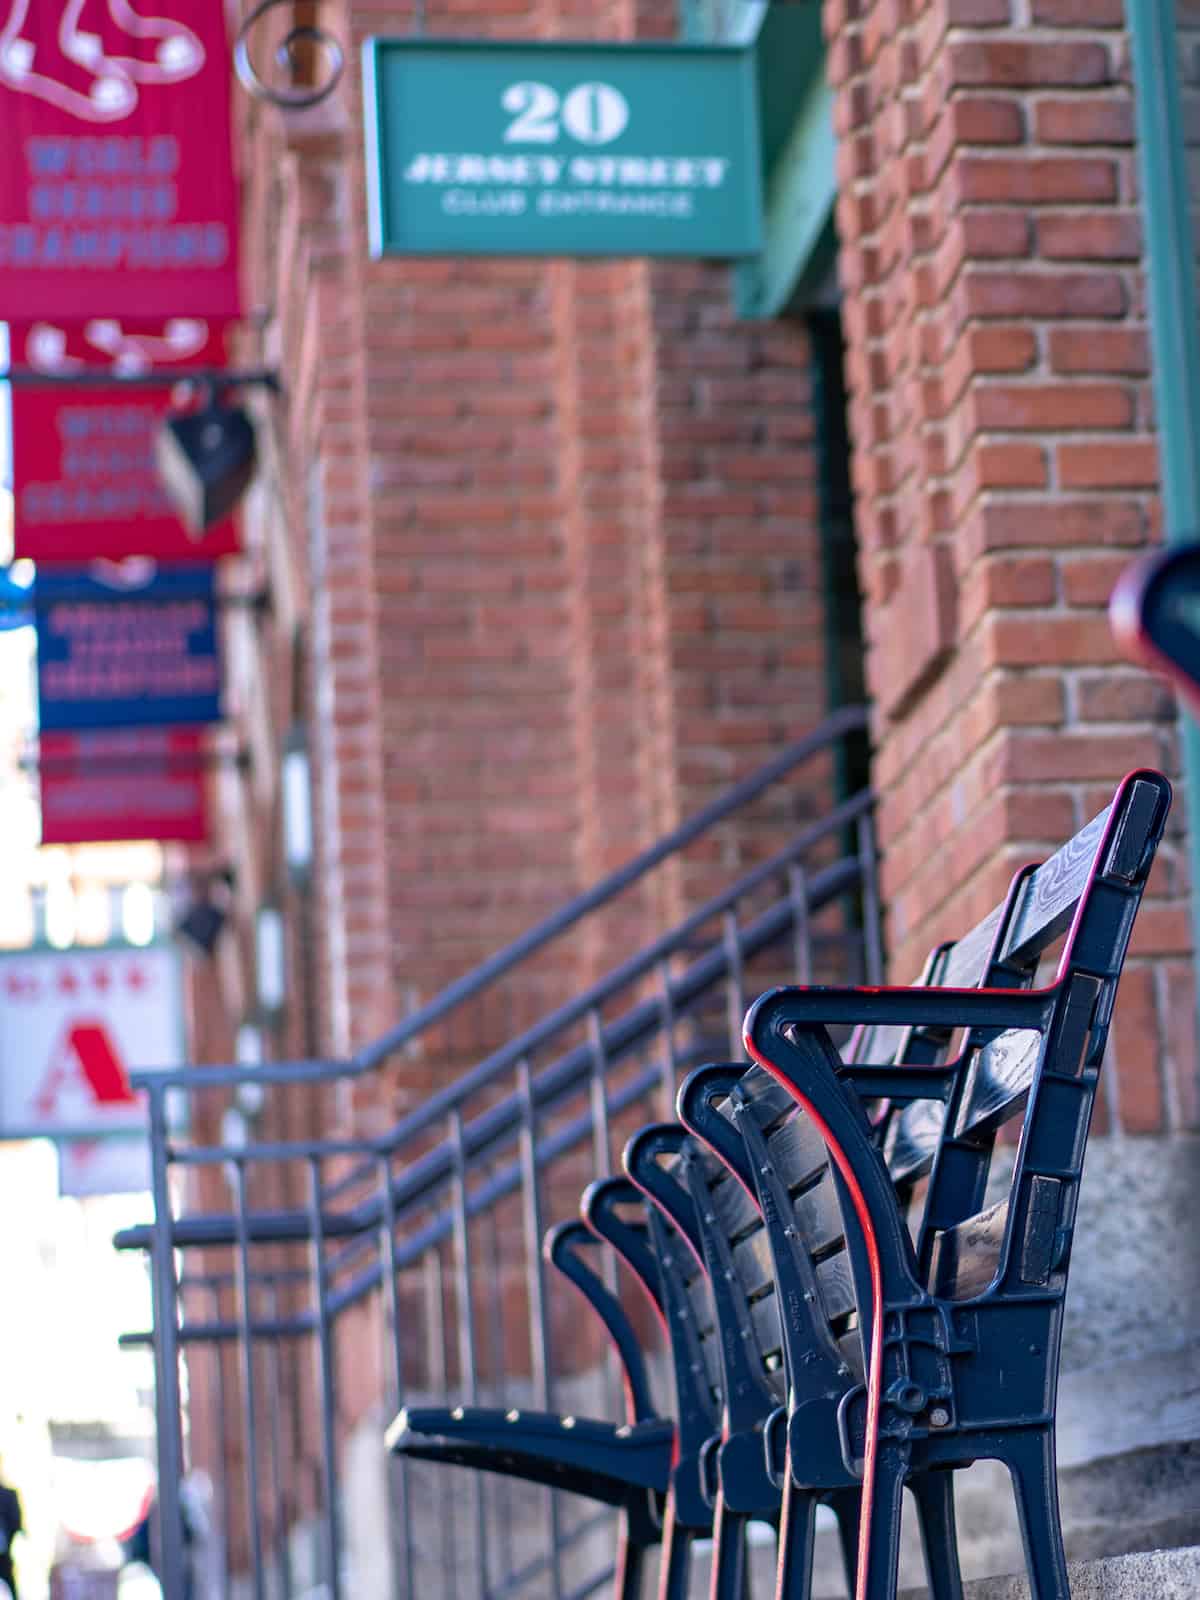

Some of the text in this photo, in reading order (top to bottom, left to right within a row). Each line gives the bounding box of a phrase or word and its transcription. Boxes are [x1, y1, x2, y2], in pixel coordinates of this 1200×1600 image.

[501, 80, 629, 145] 20
[403, 153, 729, 188] JERSEY STREET
[441, 189, 695, 219] CLUB ENTRANCE
